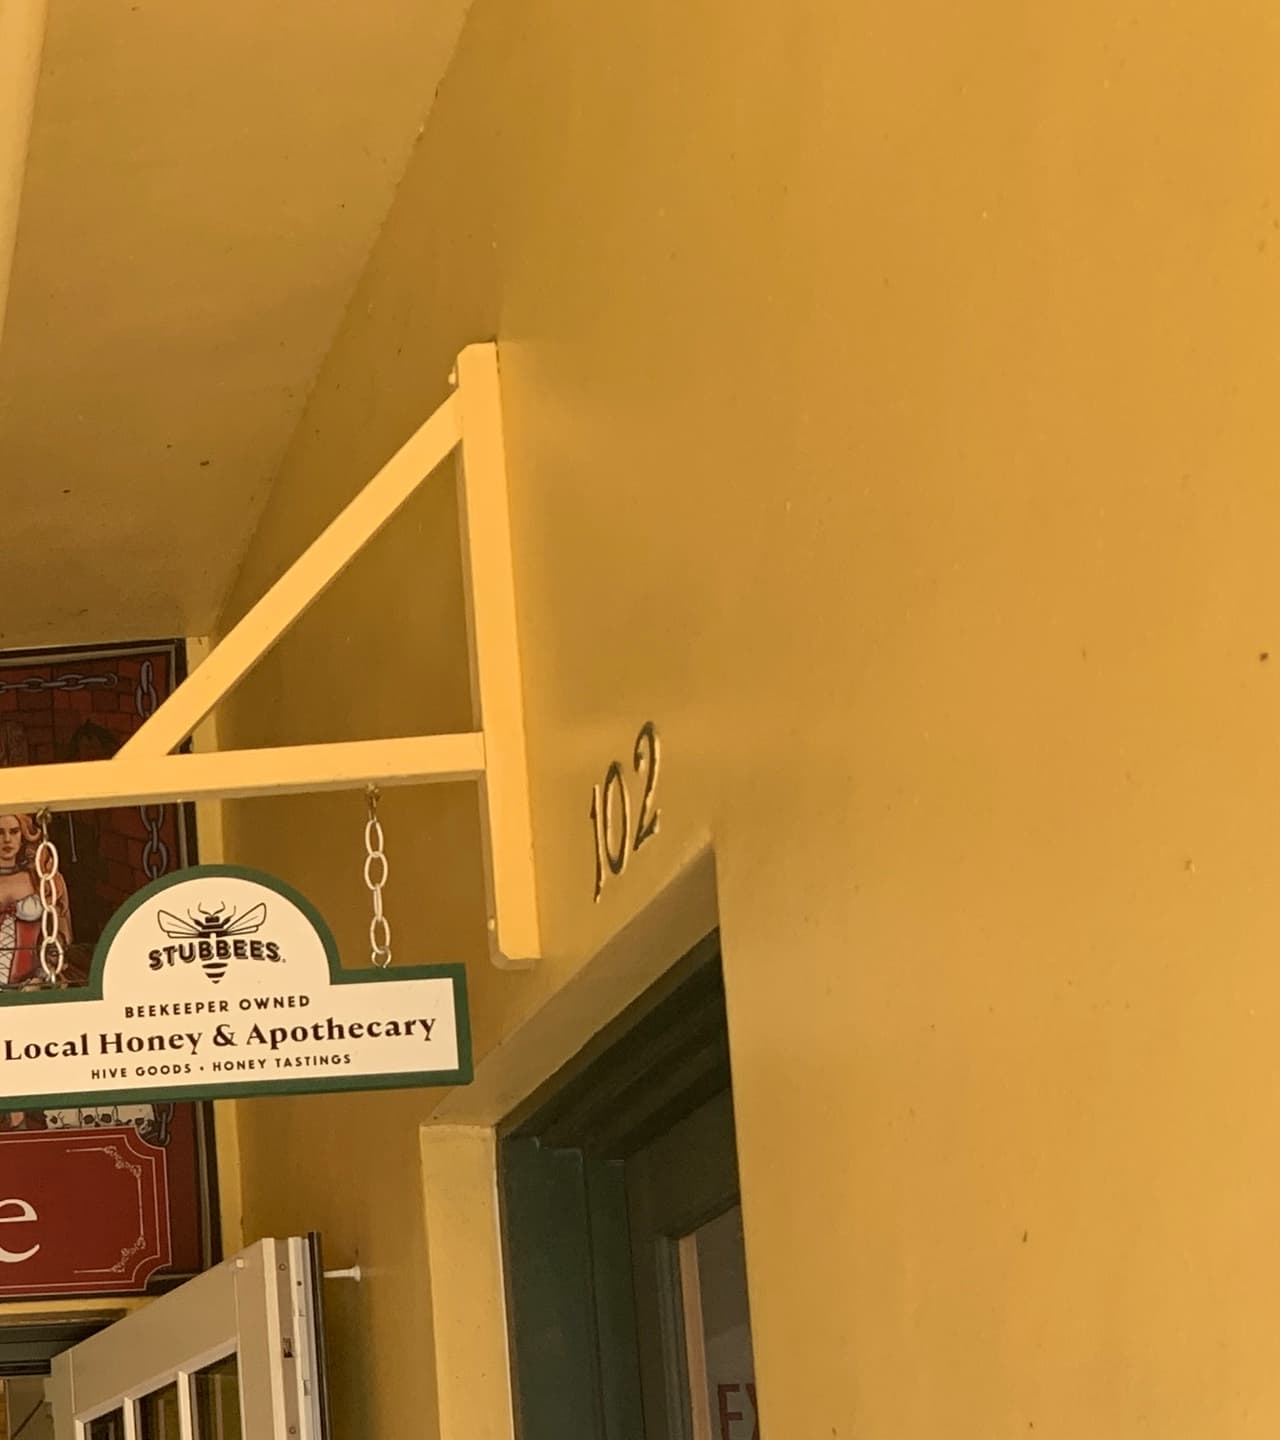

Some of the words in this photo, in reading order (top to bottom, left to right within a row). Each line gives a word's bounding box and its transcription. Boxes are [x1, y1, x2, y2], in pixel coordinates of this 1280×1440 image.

[590, 721, 660, 903] 102
[148, 939, 281, 970] STUBBEES
[125, 1001, 229, 1018] BEEKEEPER
[239, 995, 310, 1011] OWNED
[4, 1033, 89, 1061] Local
[99, 1031, 203, 1056] Honey
[213, 1024, 239, 1047] &
[246, 1017, 436, 1050] Apothecary
[91, 1067, 128, 1080] HIVE
[135, 1063, 191, 1077] GOODS
[212, 1058, 267, 1072] HONEY
[275, 1053, 352, 1068] TASTINGS
